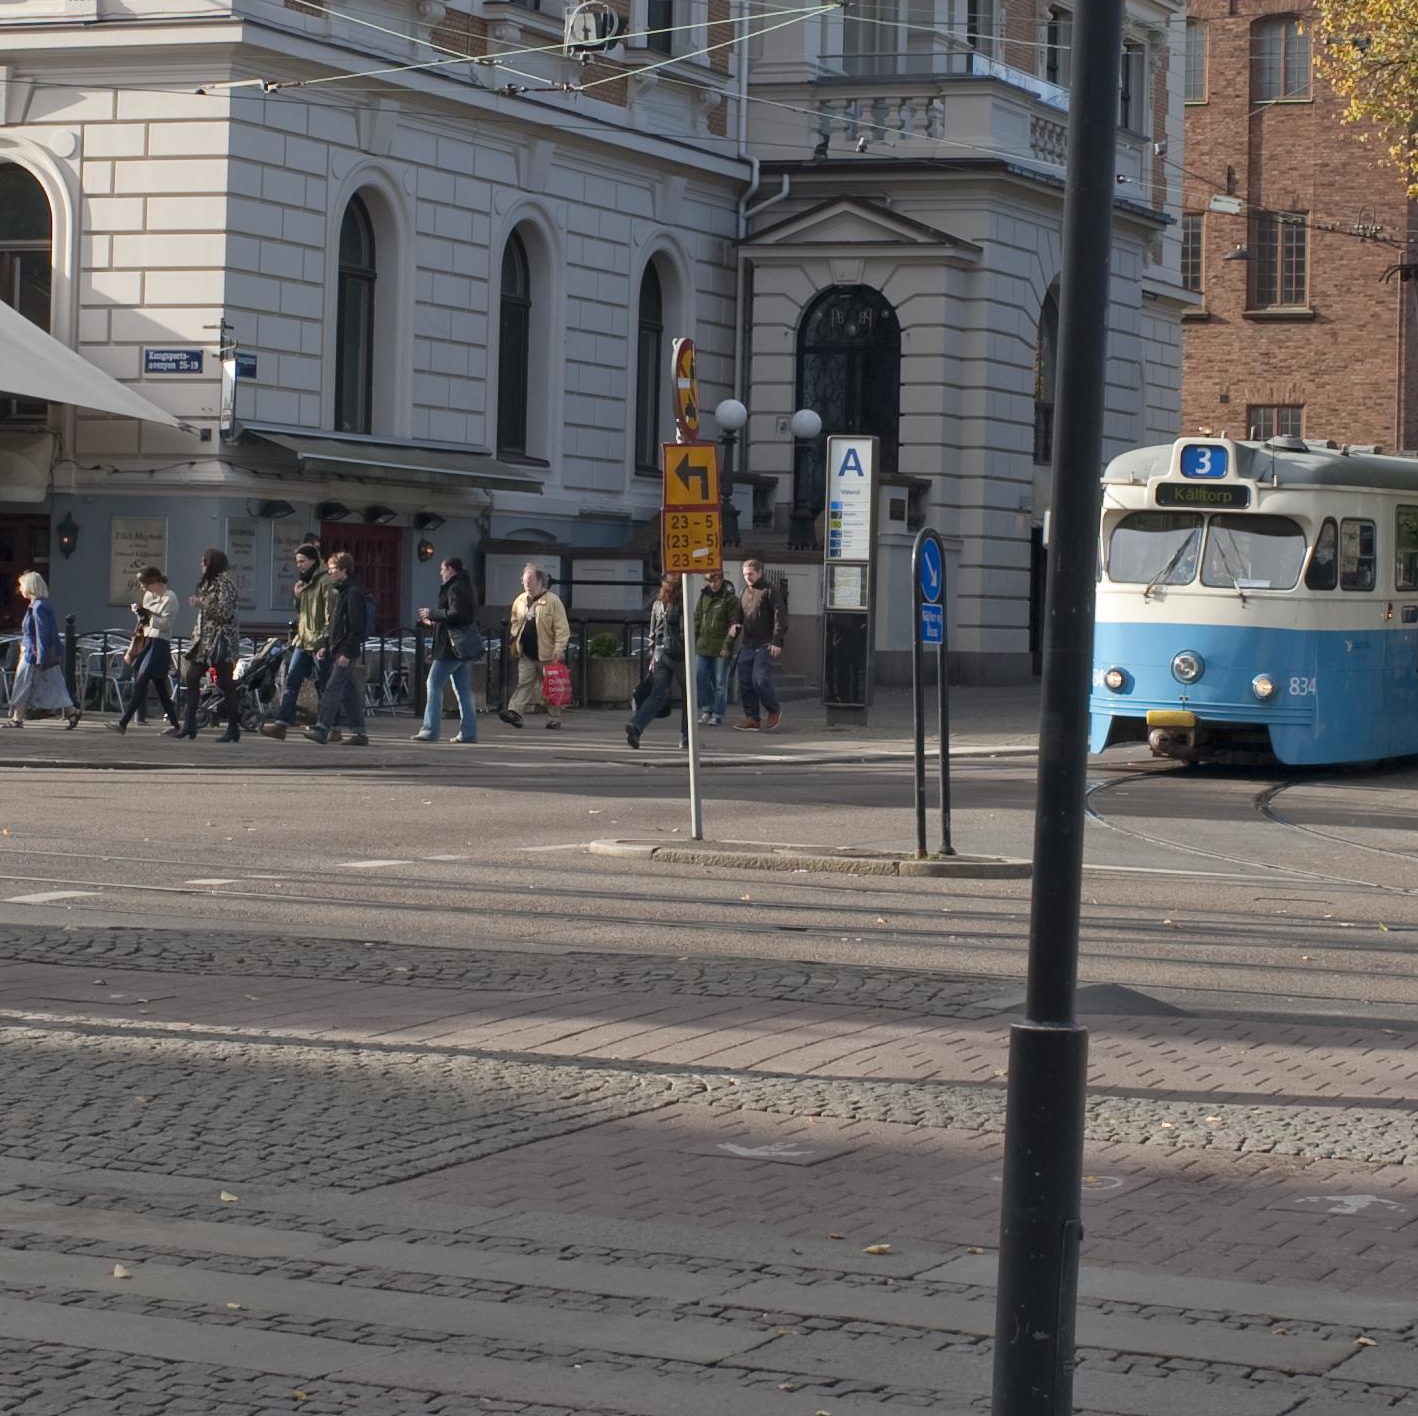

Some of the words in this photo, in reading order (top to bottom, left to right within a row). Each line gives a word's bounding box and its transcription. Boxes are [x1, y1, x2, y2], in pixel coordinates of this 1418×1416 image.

[838, 448, 864, 476] A
[1195, 447, 1212, 474] 3
[672, 515, 689, 529] 23
[705, 515, 713, 528] 5
[667, 534, 689, 549] (23
[706, 532, 718, 549] 5)
[672, 553, 689, 567] 23
[1289, 676, 1317, 696] 834
